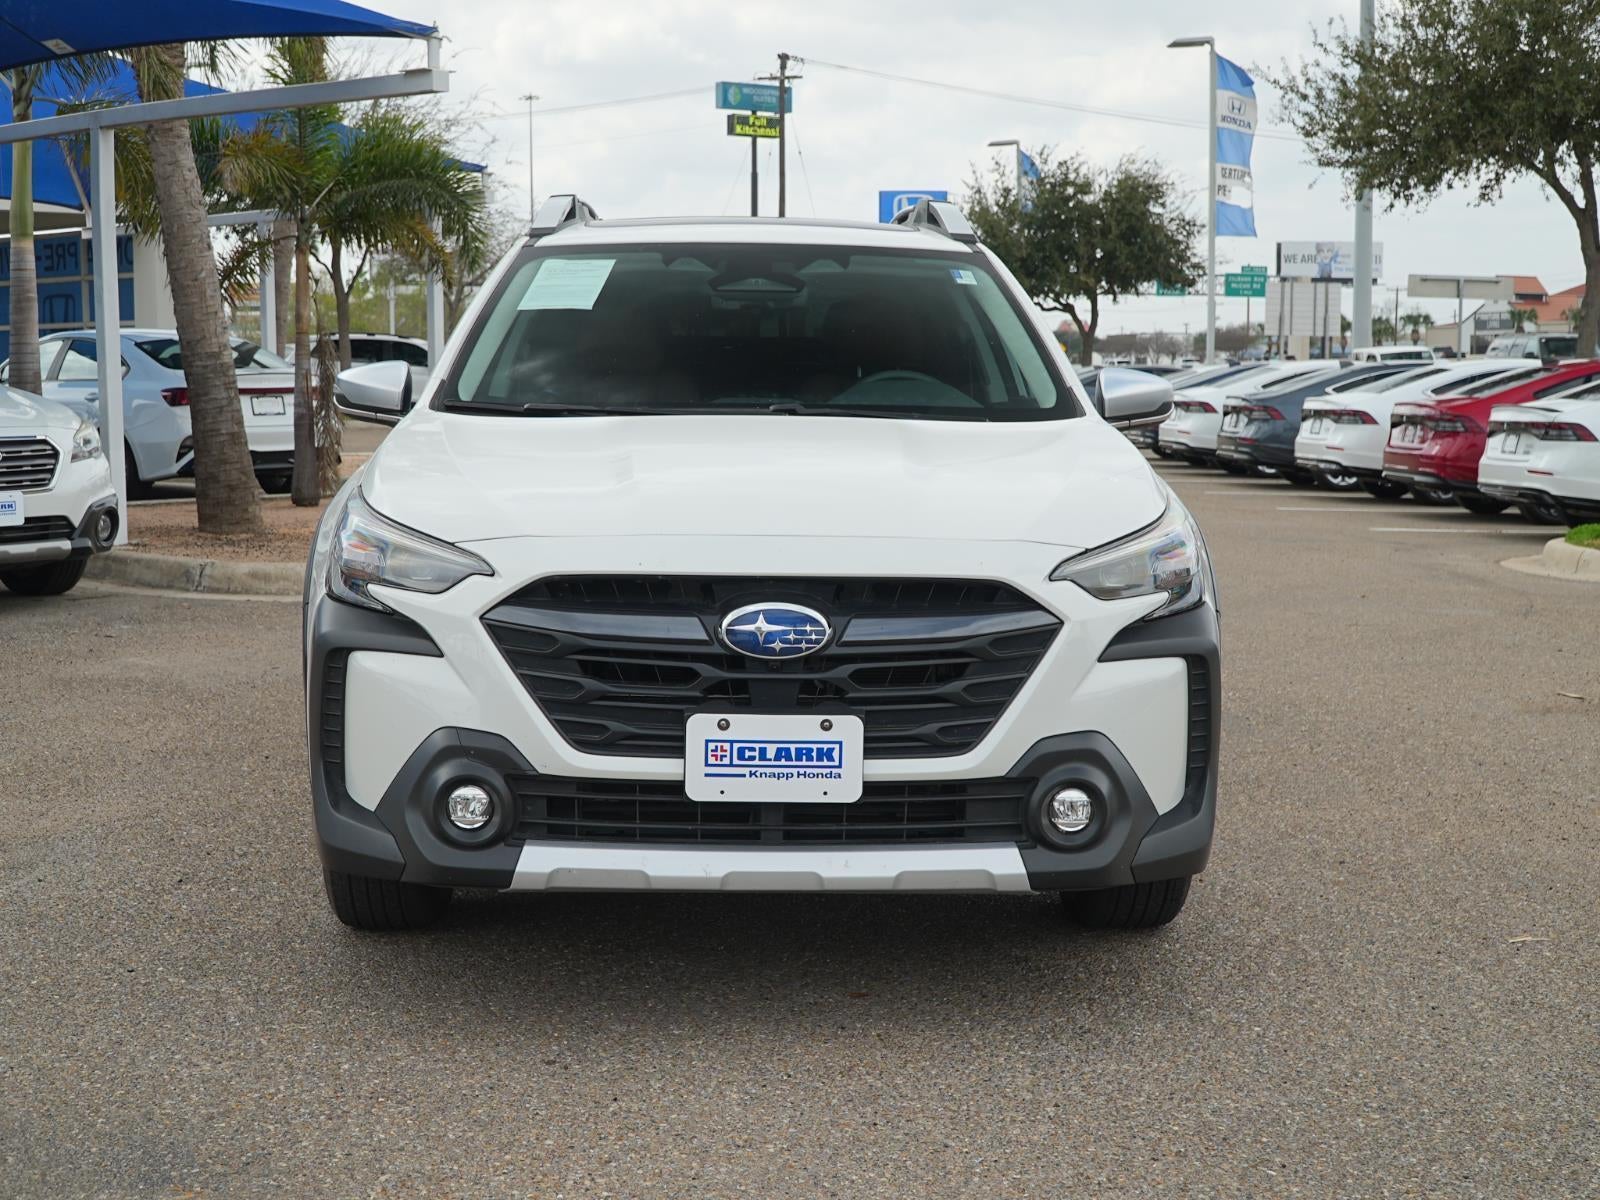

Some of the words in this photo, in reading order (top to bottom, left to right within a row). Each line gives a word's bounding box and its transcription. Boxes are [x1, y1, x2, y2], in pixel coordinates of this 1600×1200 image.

[1220, 114, 1252, 129] HONDA
[1283, 253, 1298, 265] WE
[736, 746, 836, 763] CLARK
[748, 769, 794, 781] Knapp
[796, 770, 842, 780] Honda
